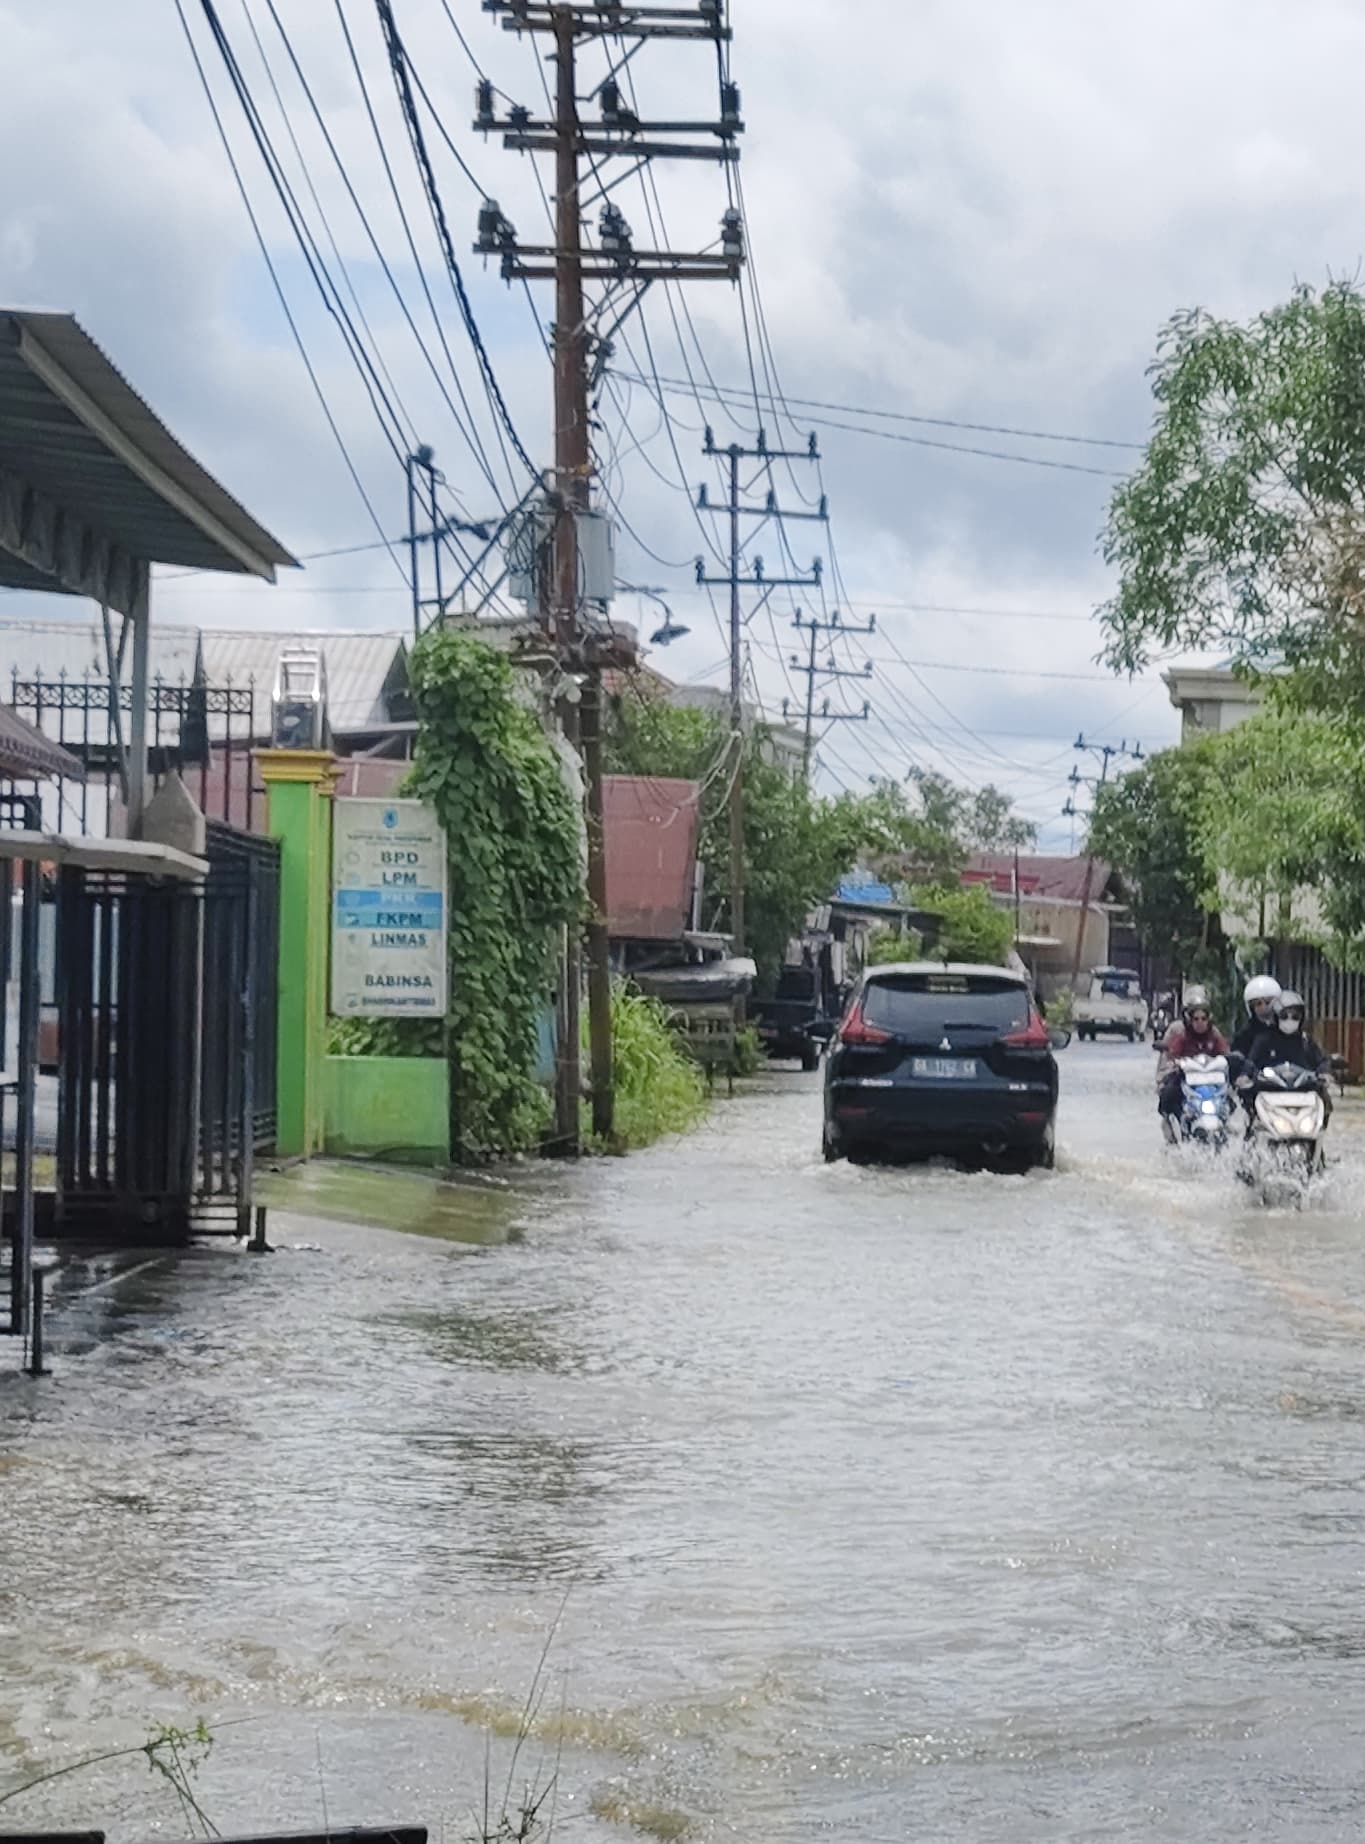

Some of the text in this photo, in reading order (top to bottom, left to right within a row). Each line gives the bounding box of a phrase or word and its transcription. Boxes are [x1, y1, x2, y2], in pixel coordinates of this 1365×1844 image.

[380, 851, 418, 864] BPD
[382, 872, 417, 885] LPM
[376, 912, 422, 925] FKPM
[371, 932, 426, 946] LINMAS
[364, 974, 433, 988] BABINSA
